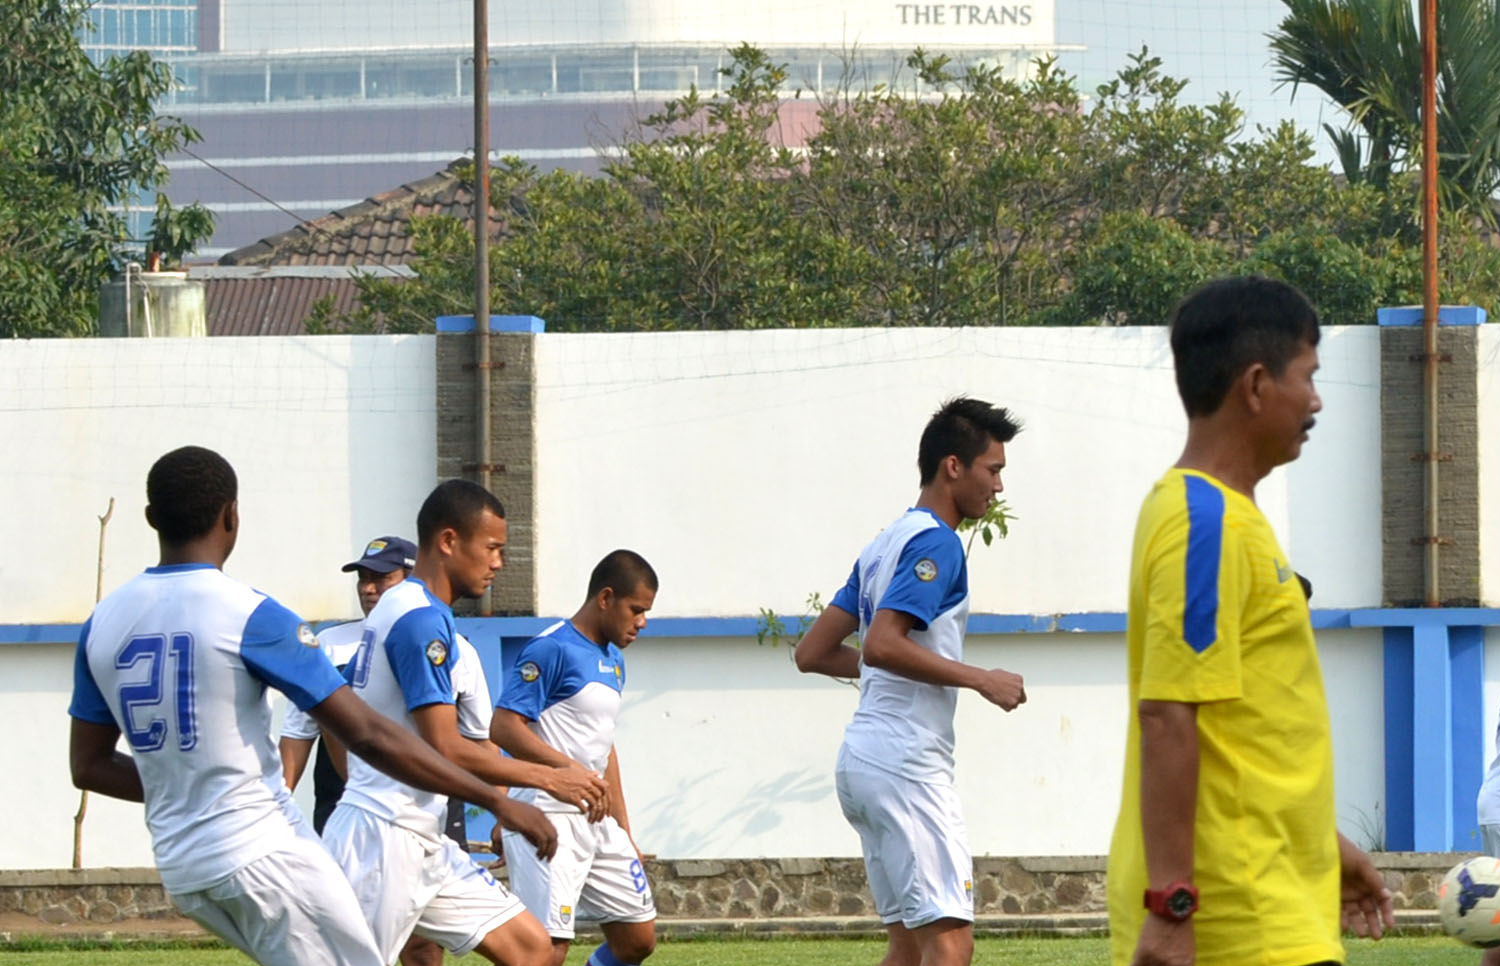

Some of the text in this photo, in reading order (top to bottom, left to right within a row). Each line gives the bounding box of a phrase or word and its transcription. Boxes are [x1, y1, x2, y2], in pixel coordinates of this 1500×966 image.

[896, 4, 1033, 26] THE TRANS
[115, 631, 198, 752] 21
